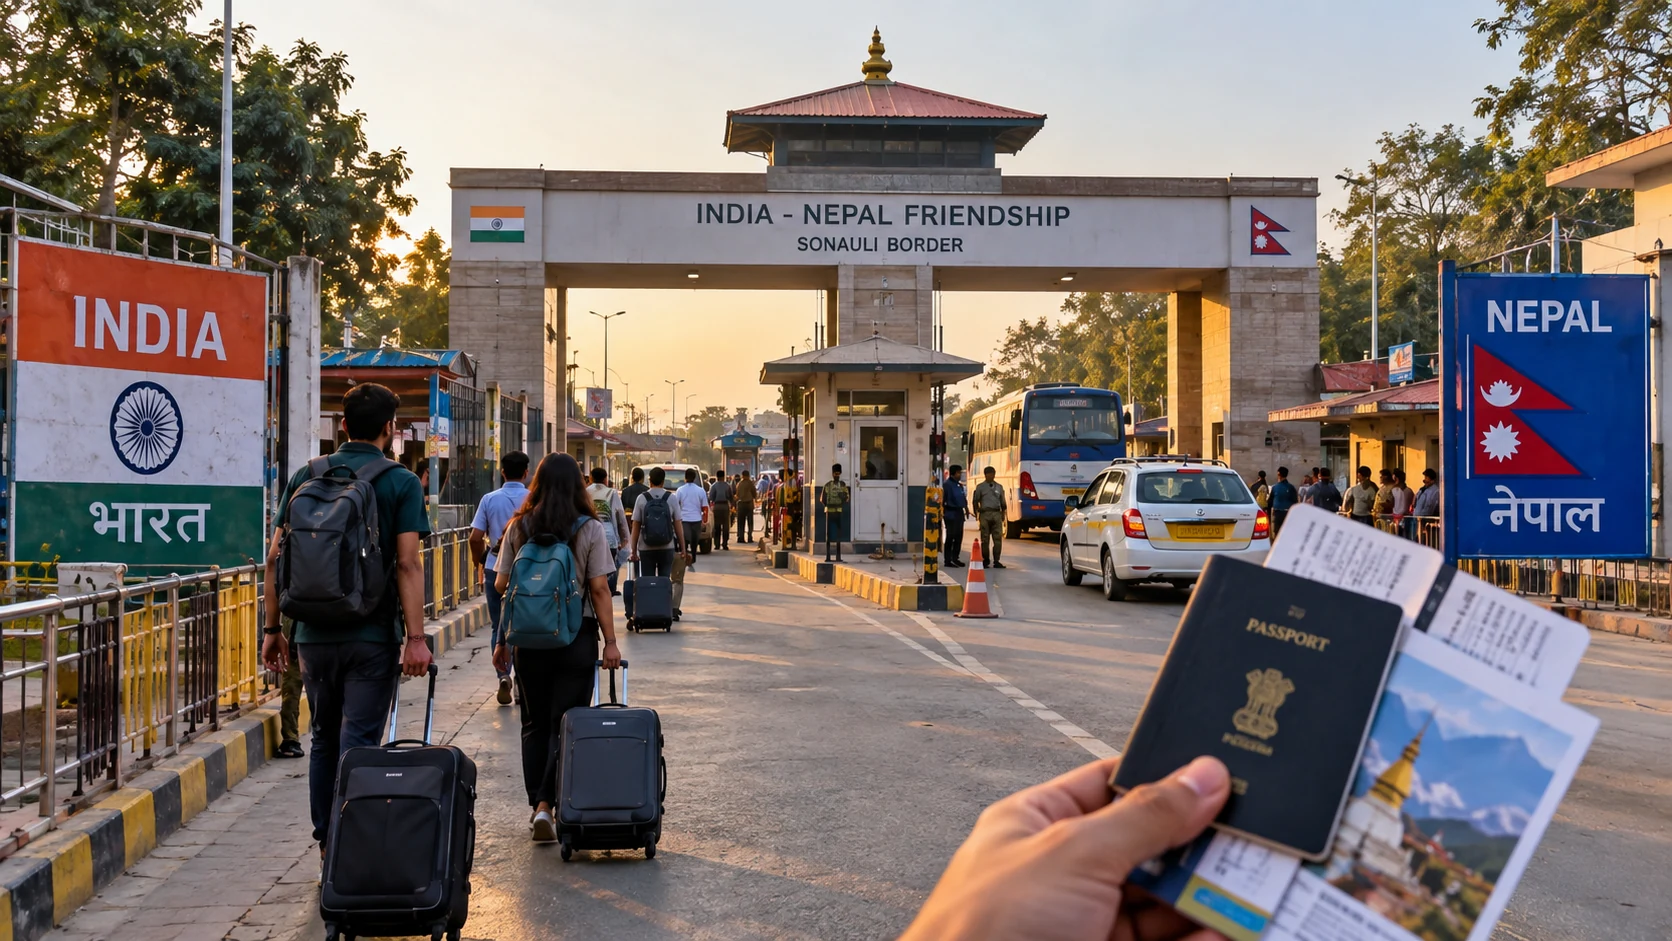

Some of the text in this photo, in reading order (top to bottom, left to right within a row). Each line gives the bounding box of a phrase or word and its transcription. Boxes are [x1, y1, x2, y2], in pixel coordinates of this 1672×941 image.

[697, 203, 774, 225] INDIA
[803, 204, 893, 226] NEPAL
[904, 205, 1070, 227] FRIENDSHIP
[797, 237, 964, 253] SONAULI BORDER
[73, 295, 227, 362] INDIA
[1487, 300, 1613, 333] NEPAL
[89, 501, 211, 544] भारत
[1487, 484, 1606, 533] नेपाल
[1246, 617, 1331, 652] PASSPORT
